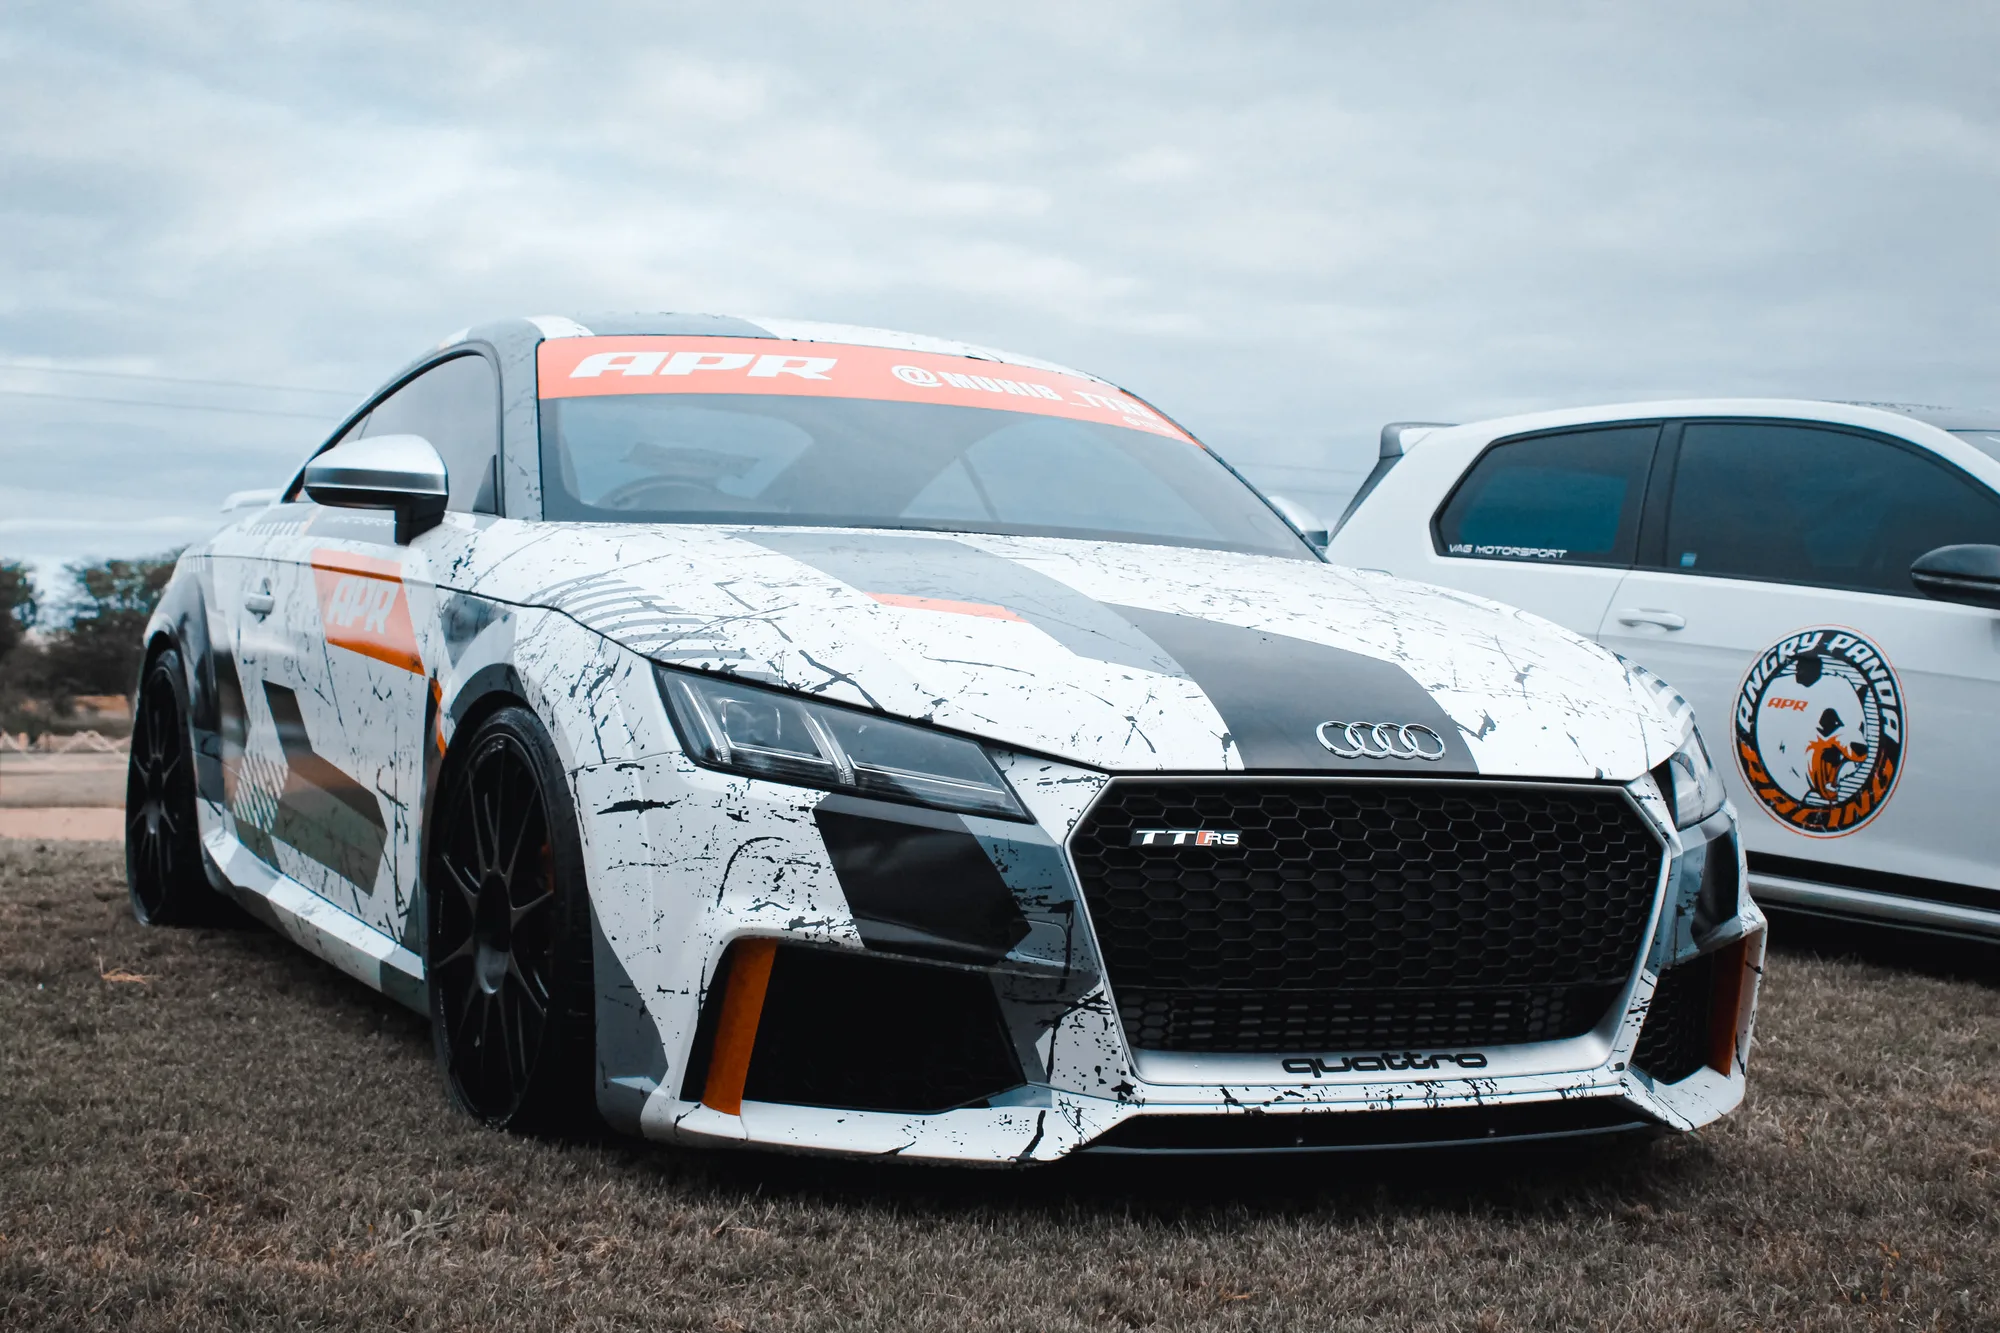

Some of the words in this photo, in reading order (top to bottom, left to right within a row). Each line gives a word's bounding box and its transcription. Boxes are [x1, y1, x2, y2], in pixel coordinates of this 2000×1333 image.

[570, 350, 838, 380] APR
[1475, 545, 1567, 559] MOTORSPORT
[326, 576, 399, 634] APR
[1737, 631, 1823, 734] ANGRY
[1827, 633, 1900, 743] PANDA
[1767, 697, 1808, 712] APR
[1740, 741, 1894, 828] RACING
[1282, 1052, 1487, 1078] quattro
